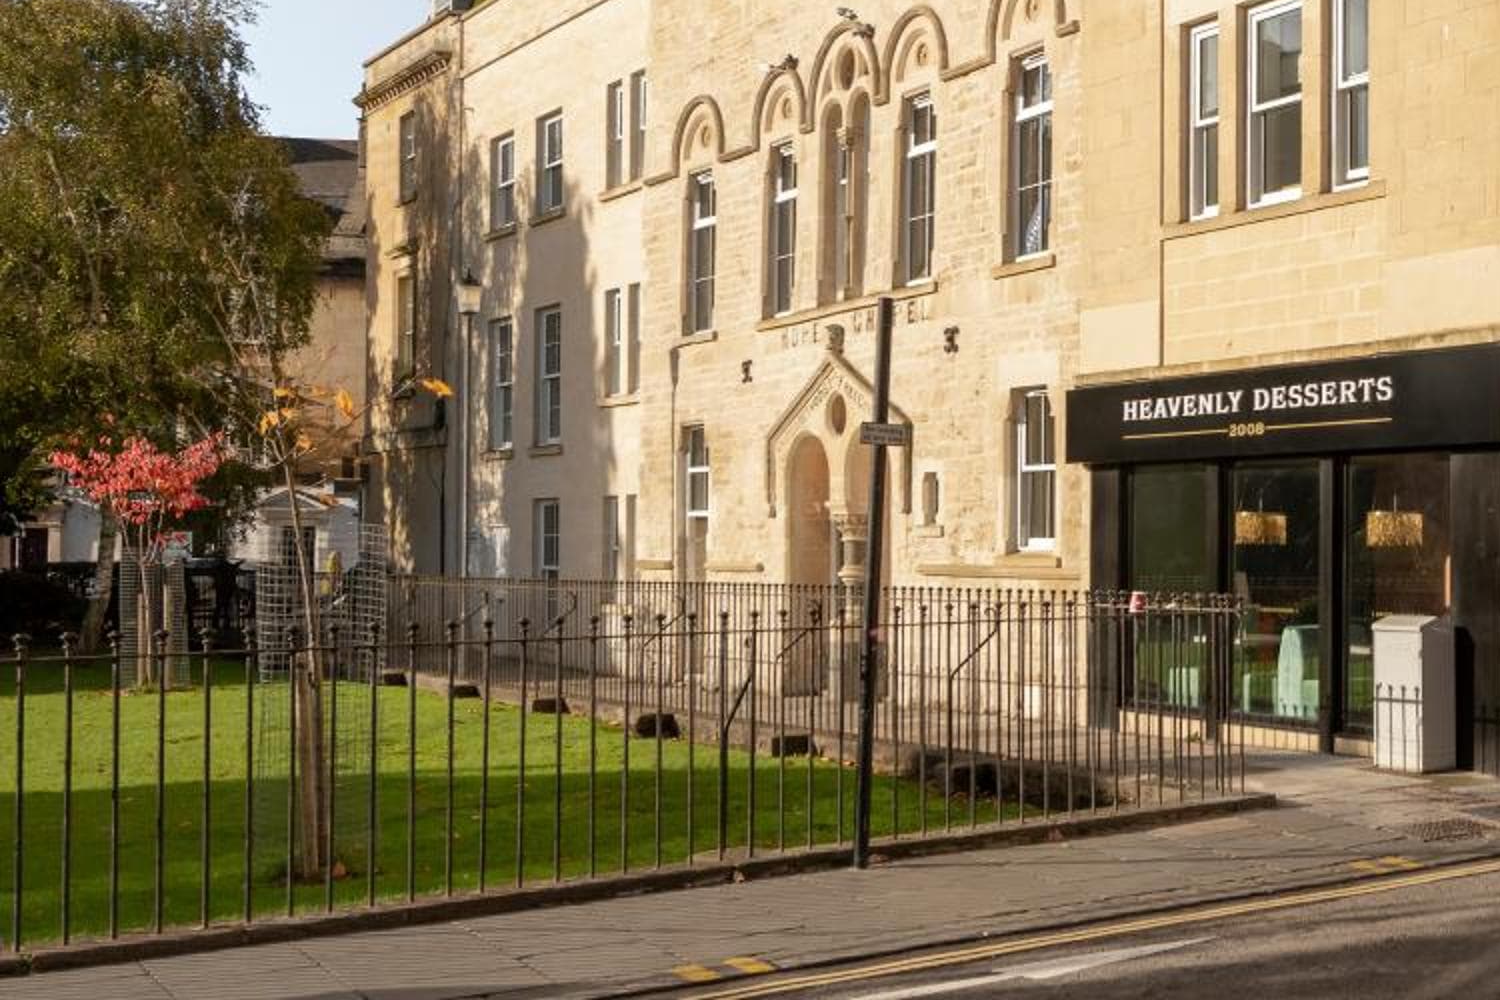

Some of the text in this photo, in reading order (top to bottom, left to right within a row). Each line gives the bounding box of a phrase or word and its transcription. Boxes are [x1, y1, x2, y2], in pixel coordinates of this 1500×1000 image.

[1123, 376, 1393, 421] HEAVENLY DESSERTS
[1229, 422, 1265, 436] 2008
